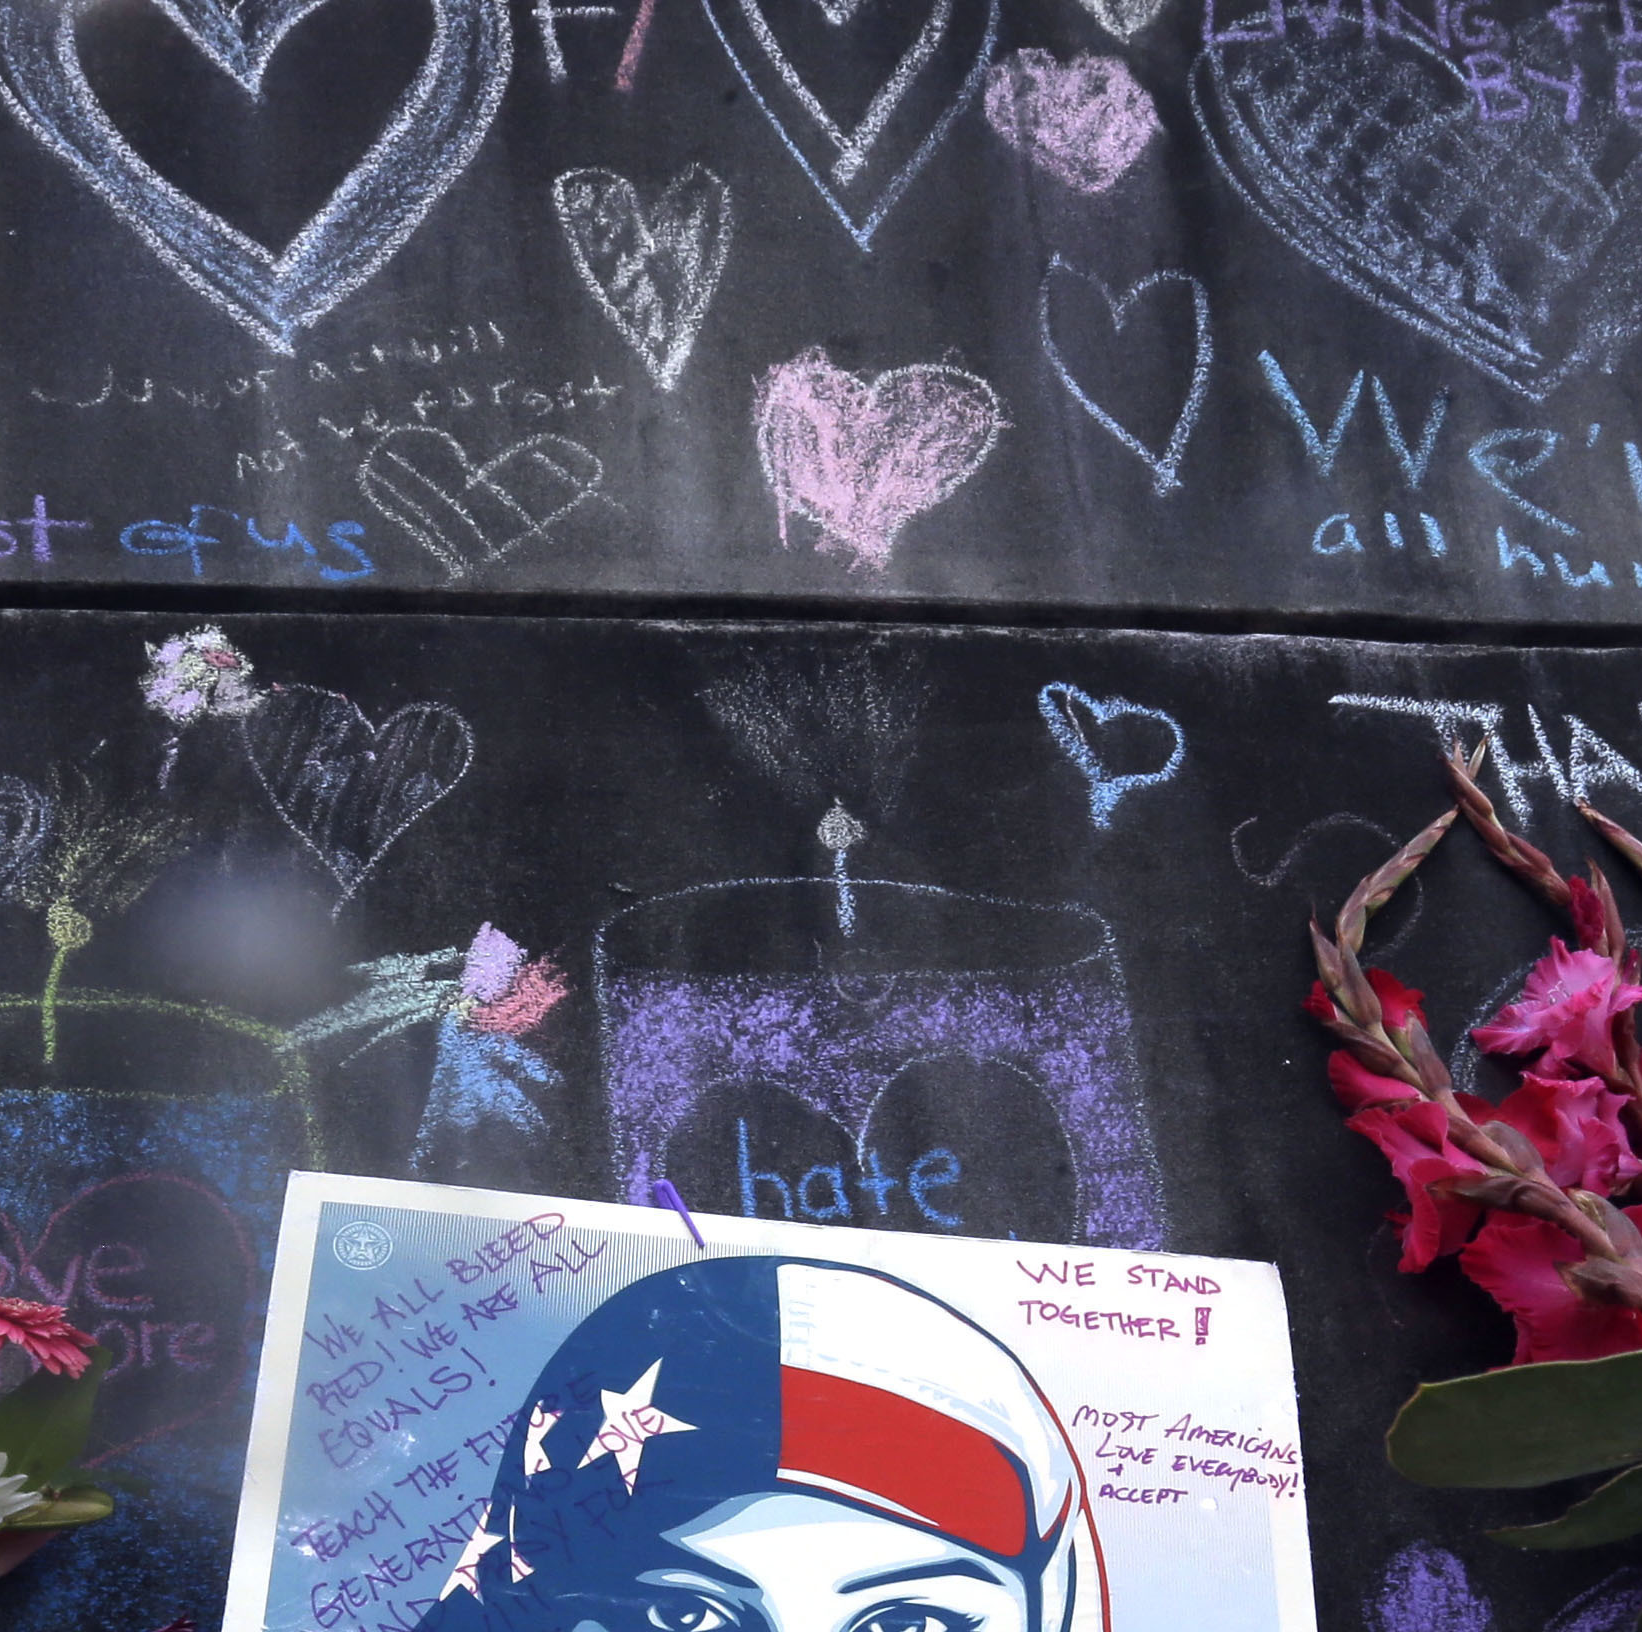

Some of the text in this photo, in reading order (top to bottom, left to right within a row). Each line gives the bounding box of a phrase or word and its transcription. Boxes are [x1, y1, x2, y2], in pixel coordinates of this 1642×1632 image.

[247, 510, 377, 581] us
[1312, 511, 1449, 559] all
[736, 1117, 965, 1230] hate
[371, 1278, 445, 1330] ALL
[445, 1212, 566, 1285] BLEED
[400, 1320, 458, 1361] WE
[462, 1283, 520, 1331] ARE
[528, 1238, 608, 1294] ALL
[1016, 1260, 1222, 1296] WE STAND
[1071, 1404, 1299, 1466] MOST AMERICANS
[1096, 1432, 1158, 1466] LOVE
[291, 1490, 406, 1563] TEACH
[394, 1450, 459, 1498] THE
[1099, 1484, 1188, 1505] ACCEPT
